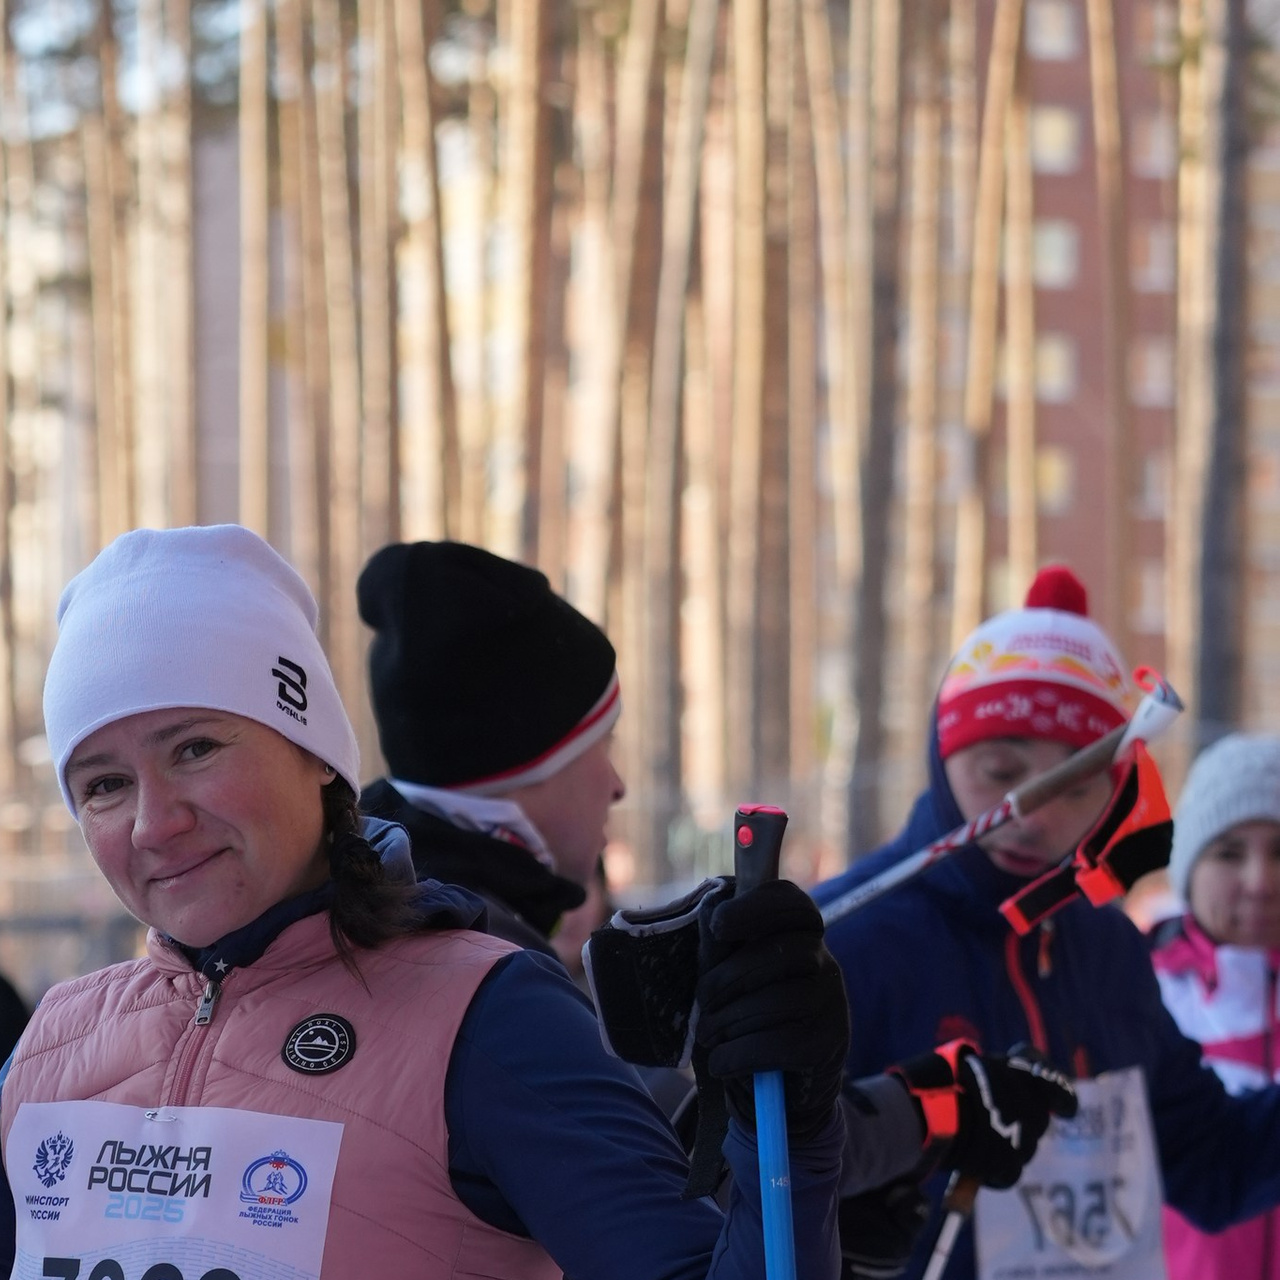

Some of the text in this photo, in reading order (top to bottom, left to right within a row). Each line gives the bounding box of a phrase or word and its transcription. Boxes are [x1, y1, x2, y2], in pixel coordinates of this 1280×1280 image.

[95, 1140, 212, 1171] ЛЫЖНЯ
[87, 1166, 212, 1198] РОССИИ
[104, 1193, 186, 1224] 2025
[239, 1211, 299, 1224] ЛЫЖНЫХ ГОНОК
[247, 1206, 292, 1216] ФЕДЕРАЦИЯ
[252, 1219, 282, 1228] РОССИИ
